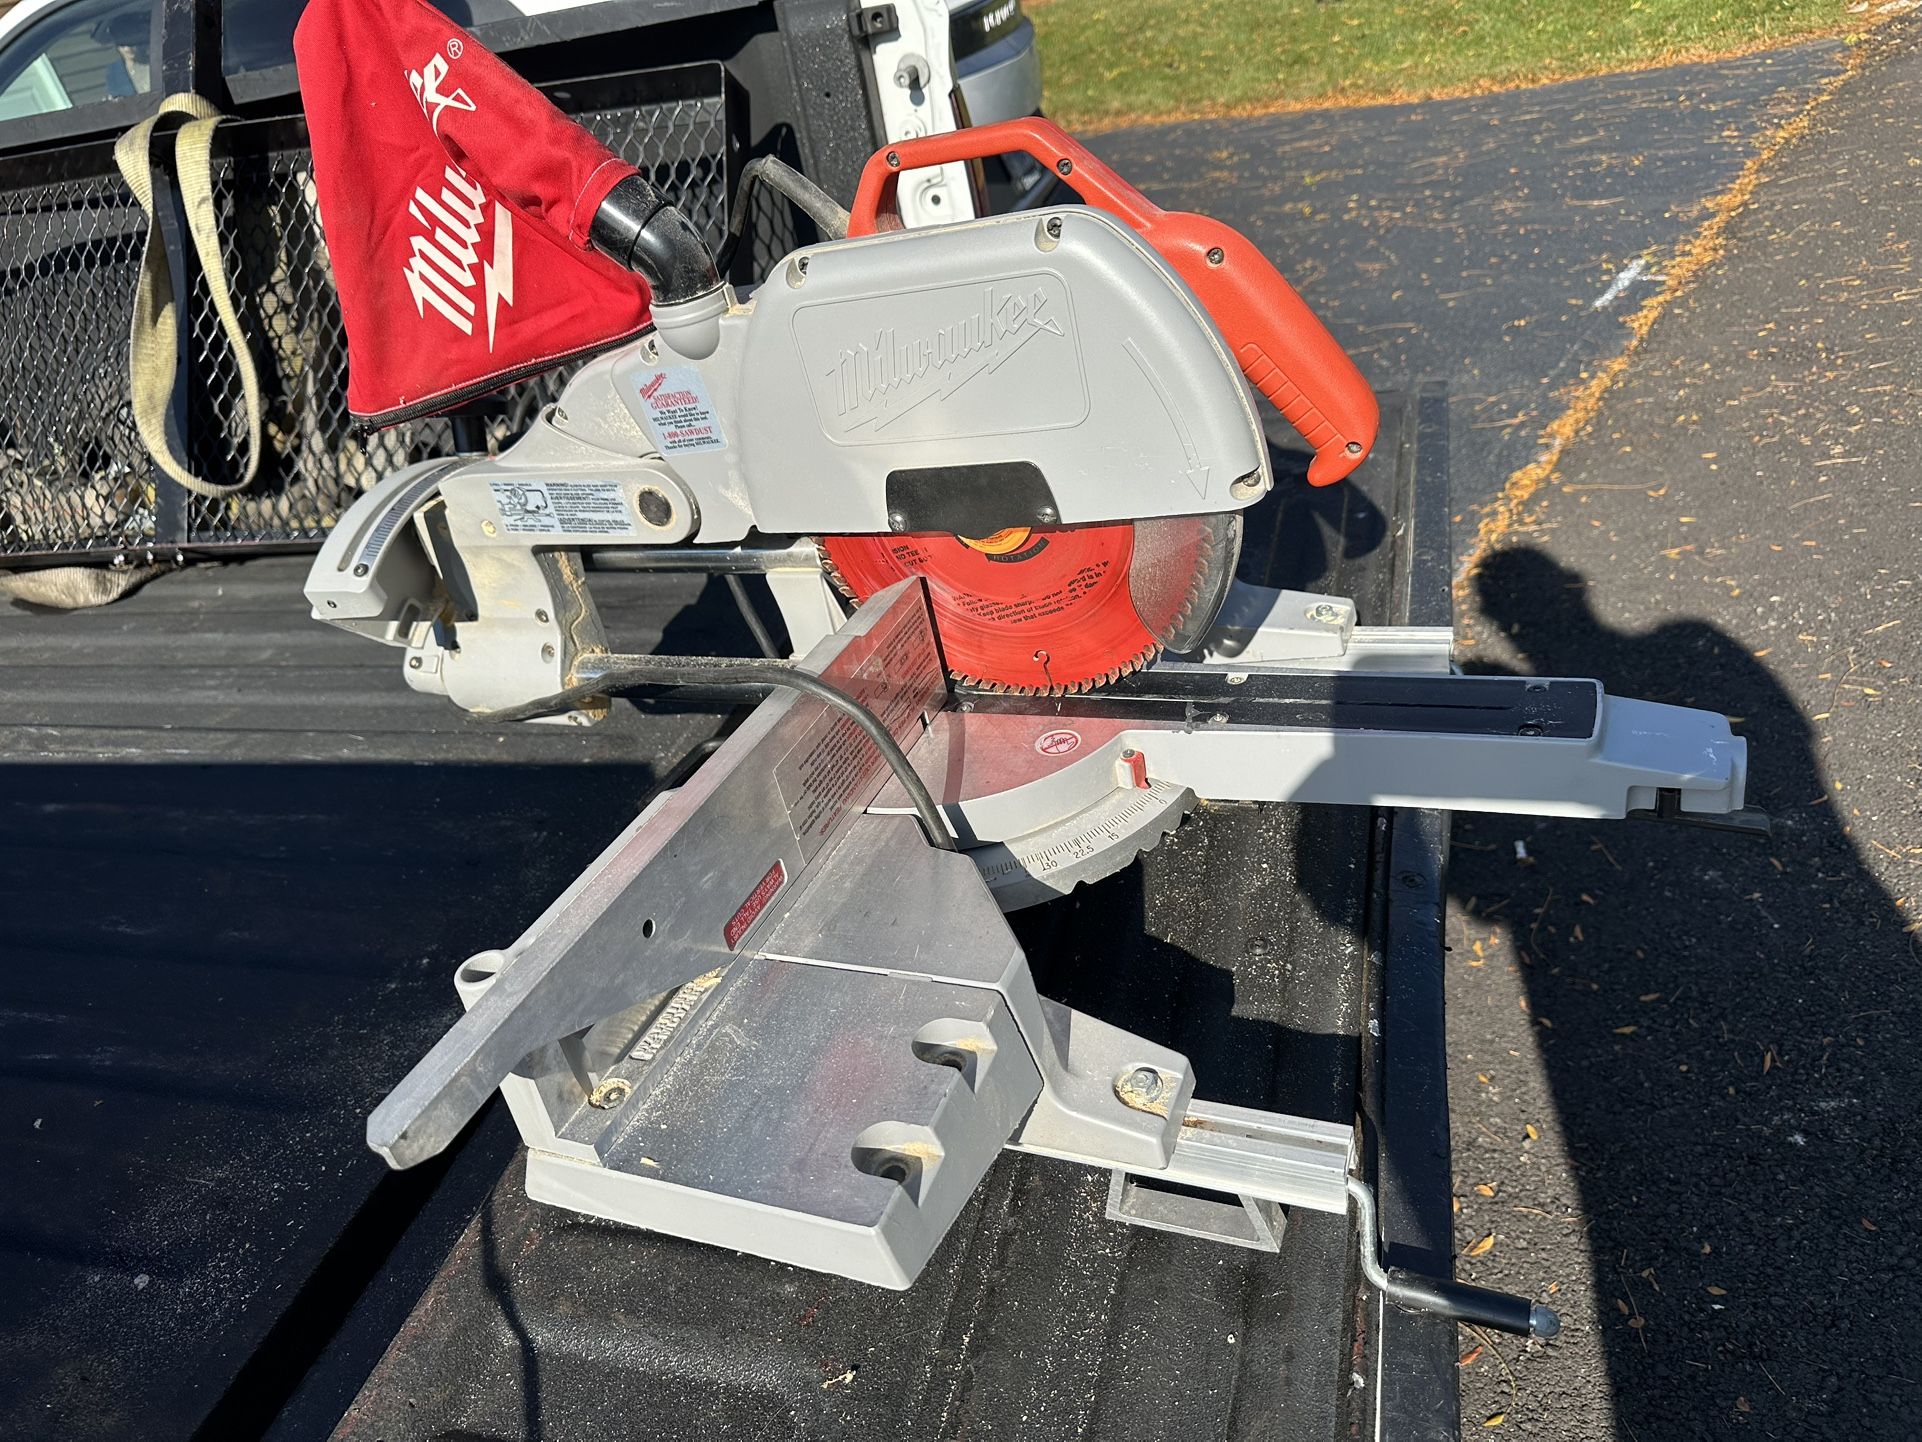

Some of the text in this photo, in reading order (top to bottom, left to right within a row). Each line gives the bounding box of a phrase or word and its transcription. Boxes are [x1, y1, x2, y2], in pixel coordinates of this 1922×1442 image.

[825, 286, 1065, 417] Milwaukee
[650, 396, 700, 410] GUARANTEED!
[652, 390, 692, 402] SATISFACTION
[662, 426, 713, 440] 1-800-SAWDUST
[1107, 833, 1119, 841] 15
[1073, 845, 1094, 859] 22.5
[1045, 861, 1058, 870] 30
